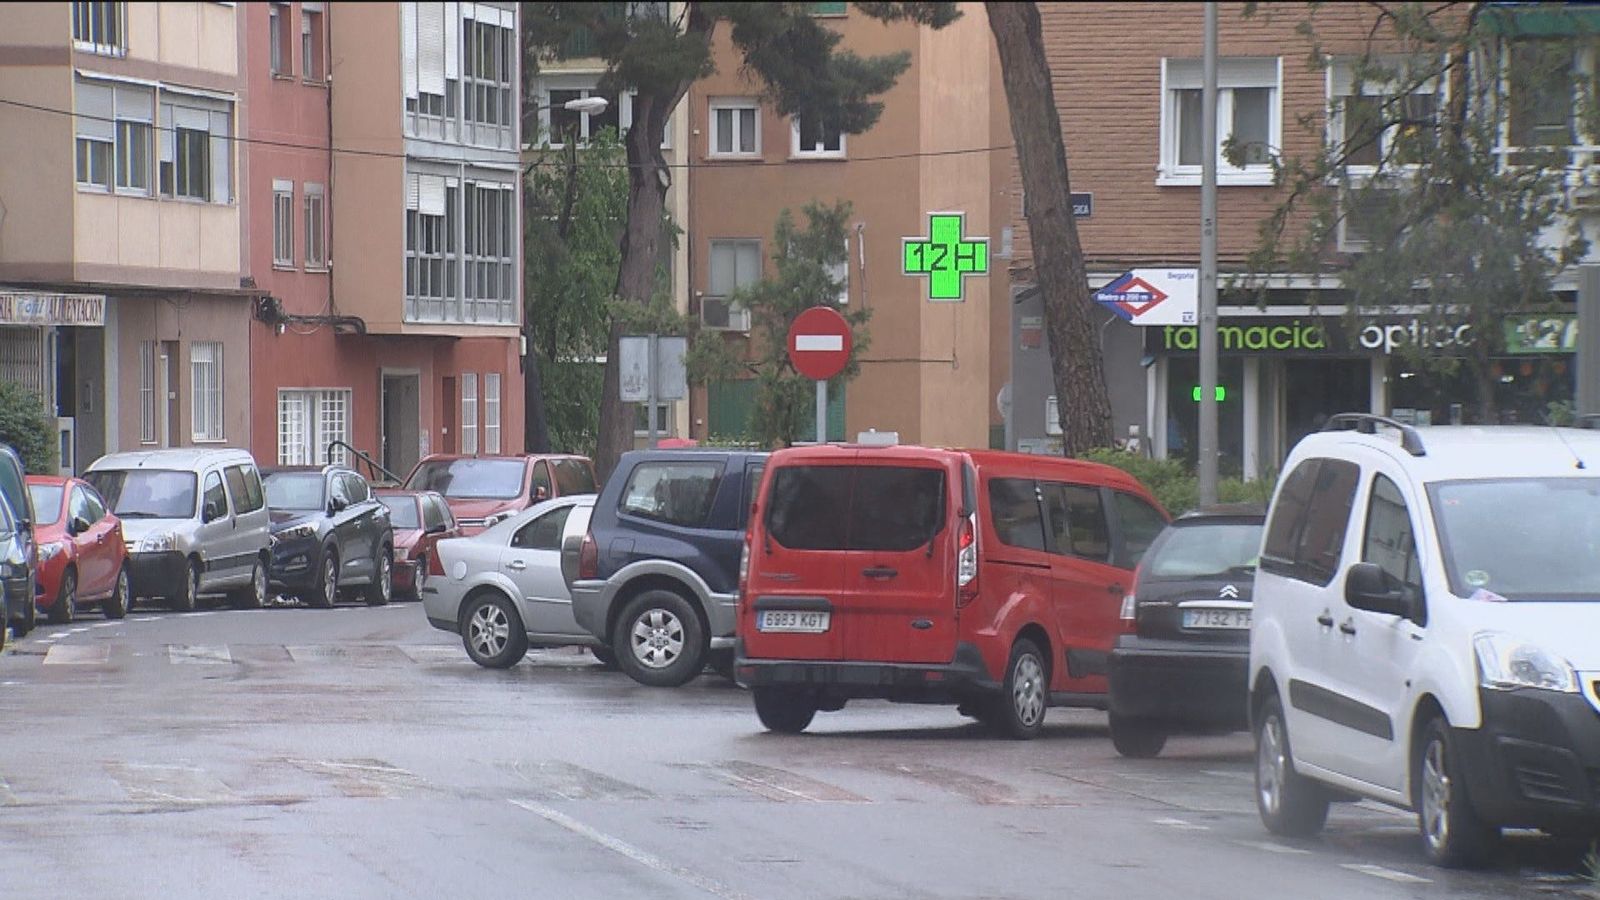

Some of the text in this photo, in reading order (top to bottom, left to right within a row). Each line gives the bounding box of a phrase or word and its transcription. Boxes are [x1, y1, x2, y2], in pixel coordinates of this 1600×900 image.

[913, 243, 976, 271] 12H
[1097, 293, 1120, 302] Metro
[1163, 320, 1326, 350] famacia
[766, 613, 825, 627] 6983 KGT
[1192, 609, 1230, 626] 7132
